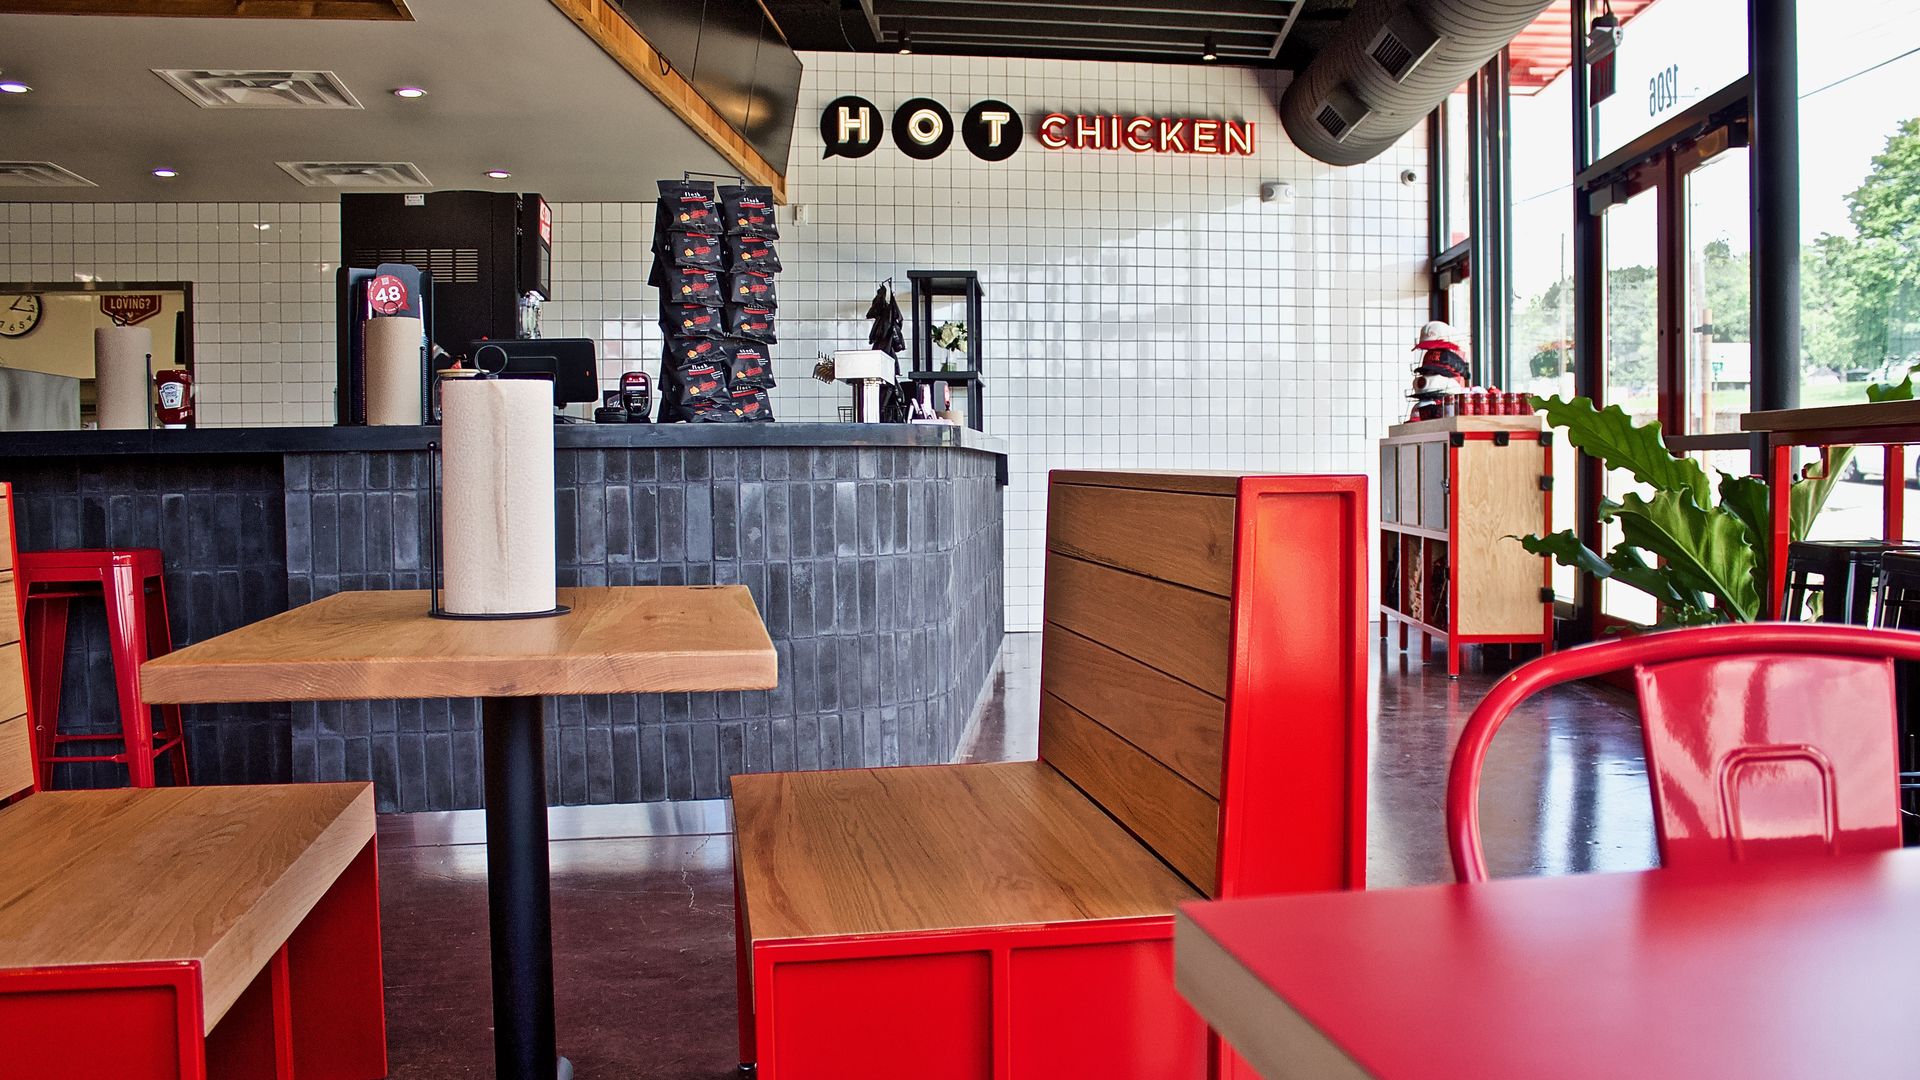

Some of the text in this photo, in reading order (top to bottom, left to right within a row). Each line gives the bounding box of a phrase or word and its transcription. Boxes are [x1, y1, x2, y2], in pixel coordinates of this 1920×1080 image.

[838, 106, 1256, 155] HOT CHICKEN
[375, 286, 401, 303] 48
[110, 298, 151, 310] LOVING?
